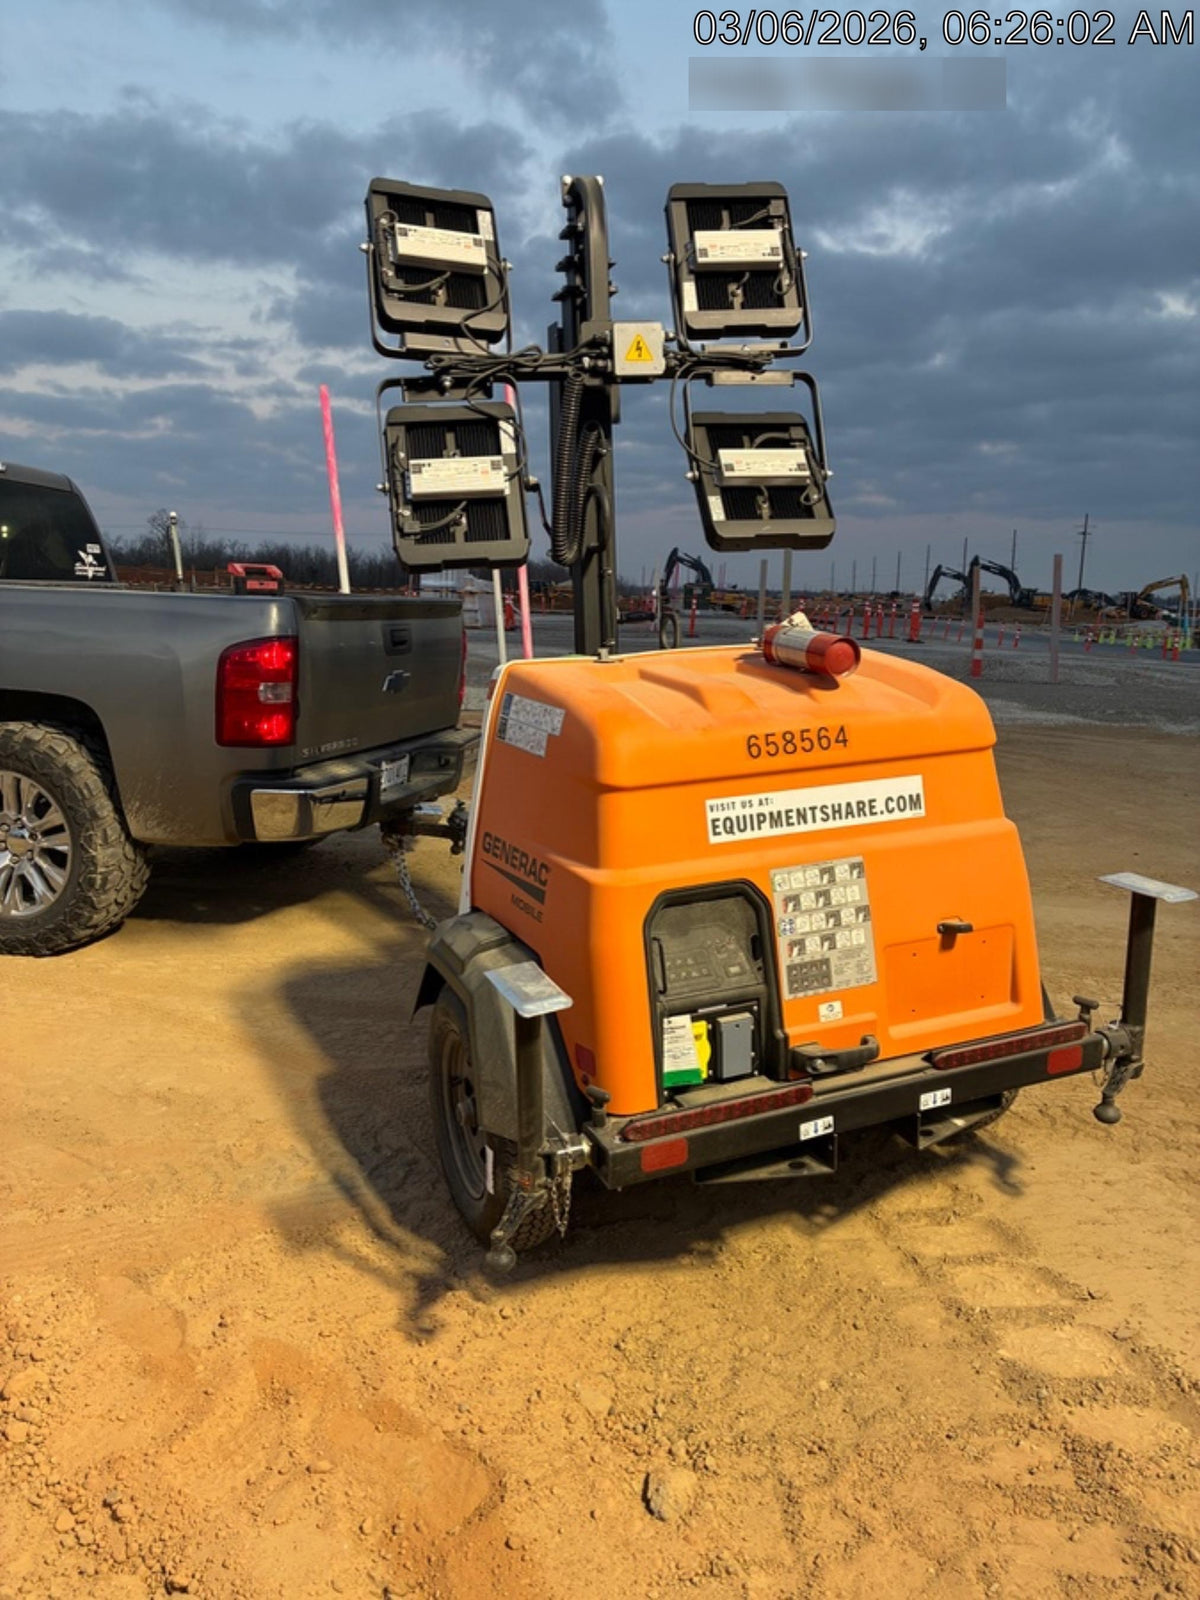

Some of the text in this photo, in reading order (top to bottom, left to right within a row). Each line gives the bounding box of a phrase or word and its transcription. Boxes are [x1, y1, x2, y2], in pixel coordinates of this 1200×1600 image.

[746, 725, 848, 759] 658564
[709, 797, 774, 812] VISIT US AT:
[711, 793, 922, 836] EQUIPMENTSHARE.COM
[483, 831, 550, 887] GENERAC
[511, 893, 544, 923] MOBILE
